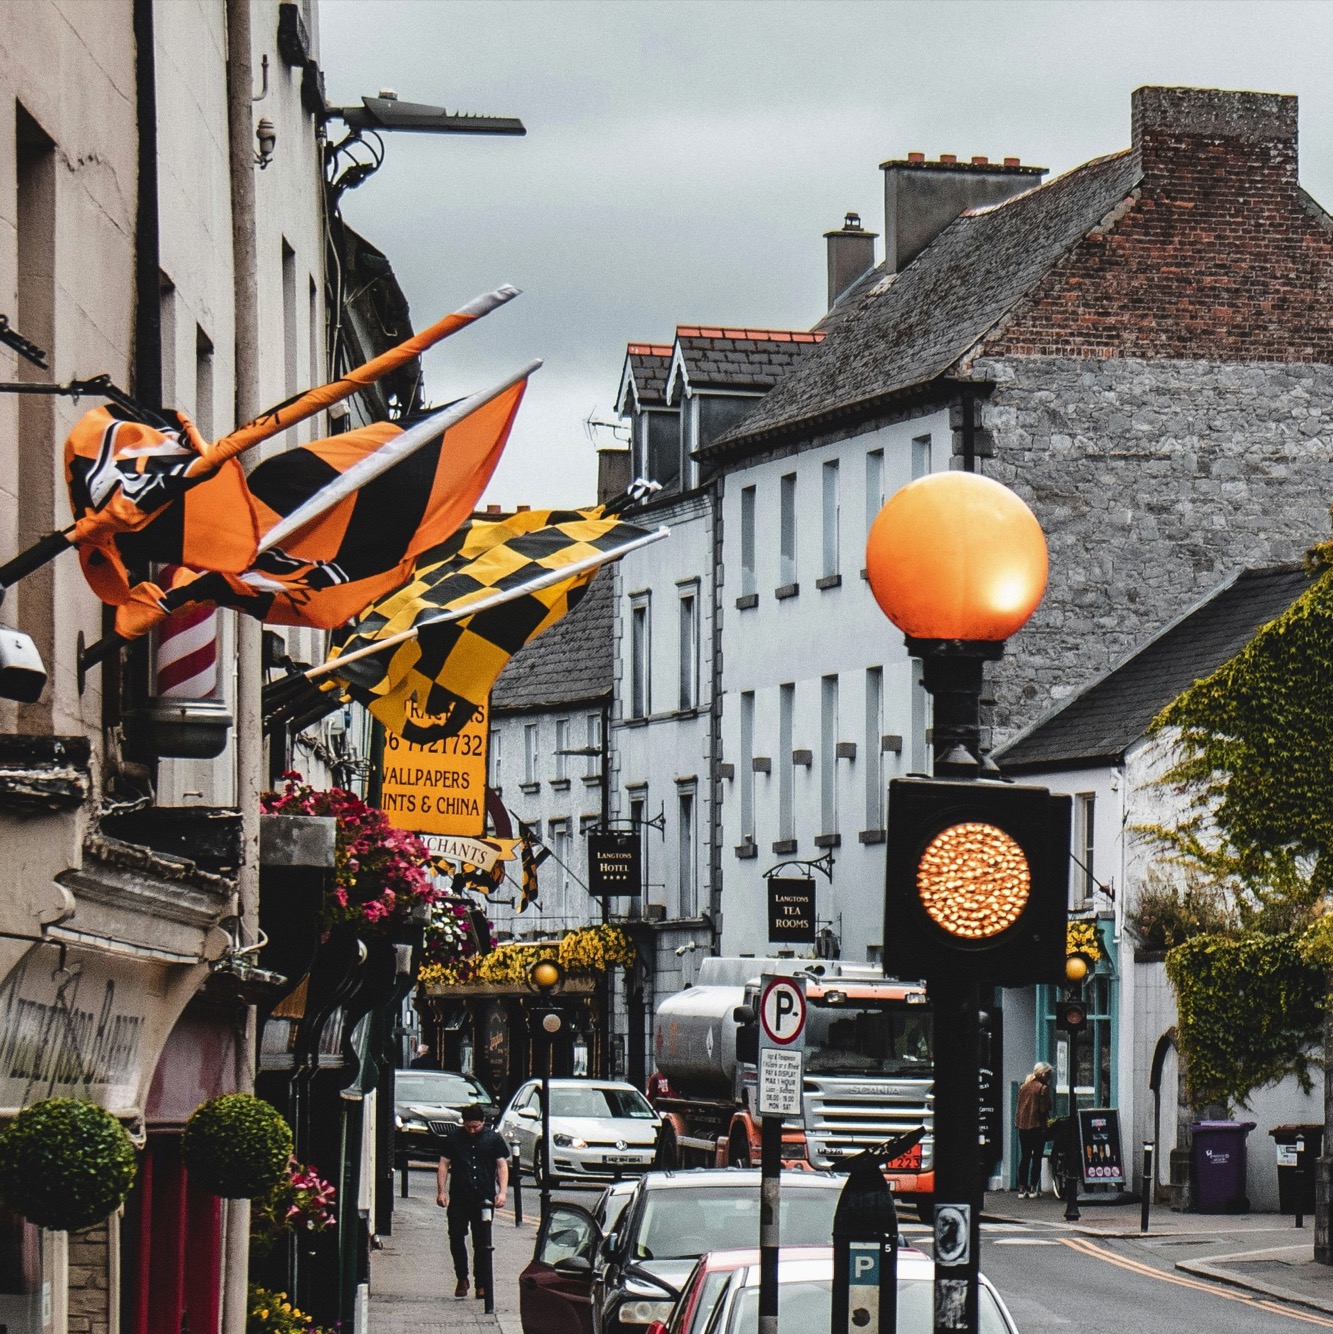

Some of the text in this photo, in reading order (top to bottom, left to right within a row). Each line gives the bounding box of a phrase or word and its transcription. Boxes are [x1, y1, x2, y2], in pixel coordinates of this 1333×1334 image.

[421, 796, 431, 812] &
[436, 797, 480, 816] CHINA
[600, 863, 629, 872] HOTEL
[775, 894, 809, 903] LANGTONS
[783, 906, 801, 915] TEA
[775, 919, 809, 928] ROOMS
[775, 990, 793, 1031] P
[885, 1244, 892, 1253] 5
[855, 1256, 875, 1279] P
